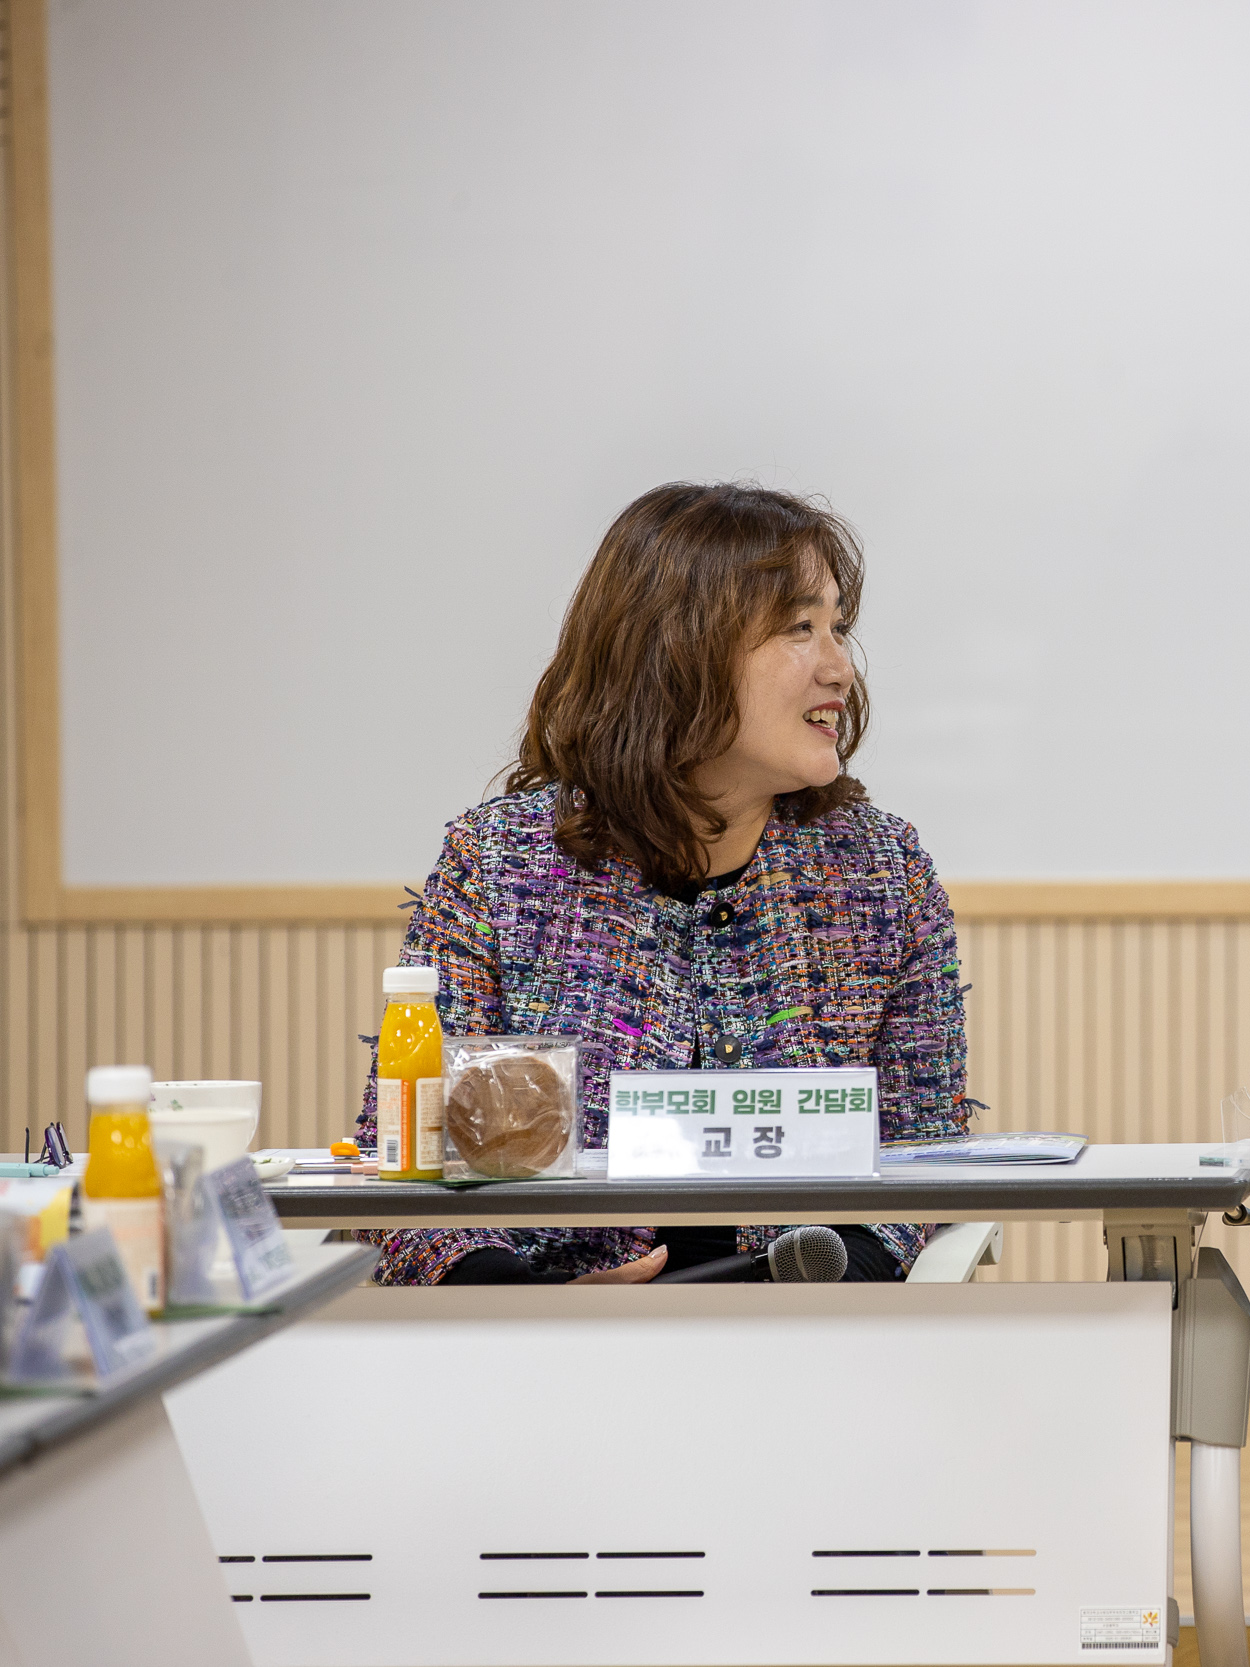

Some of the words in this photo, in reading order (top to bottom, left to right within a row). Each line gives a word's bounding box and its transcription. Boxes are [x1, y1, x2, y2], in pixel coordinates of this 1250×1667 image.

[615, 1089, 716, 1115] 학부모회
[732, 1089, 782, 1115] 임원
[798, 1087, 873, 1114] 간담회
